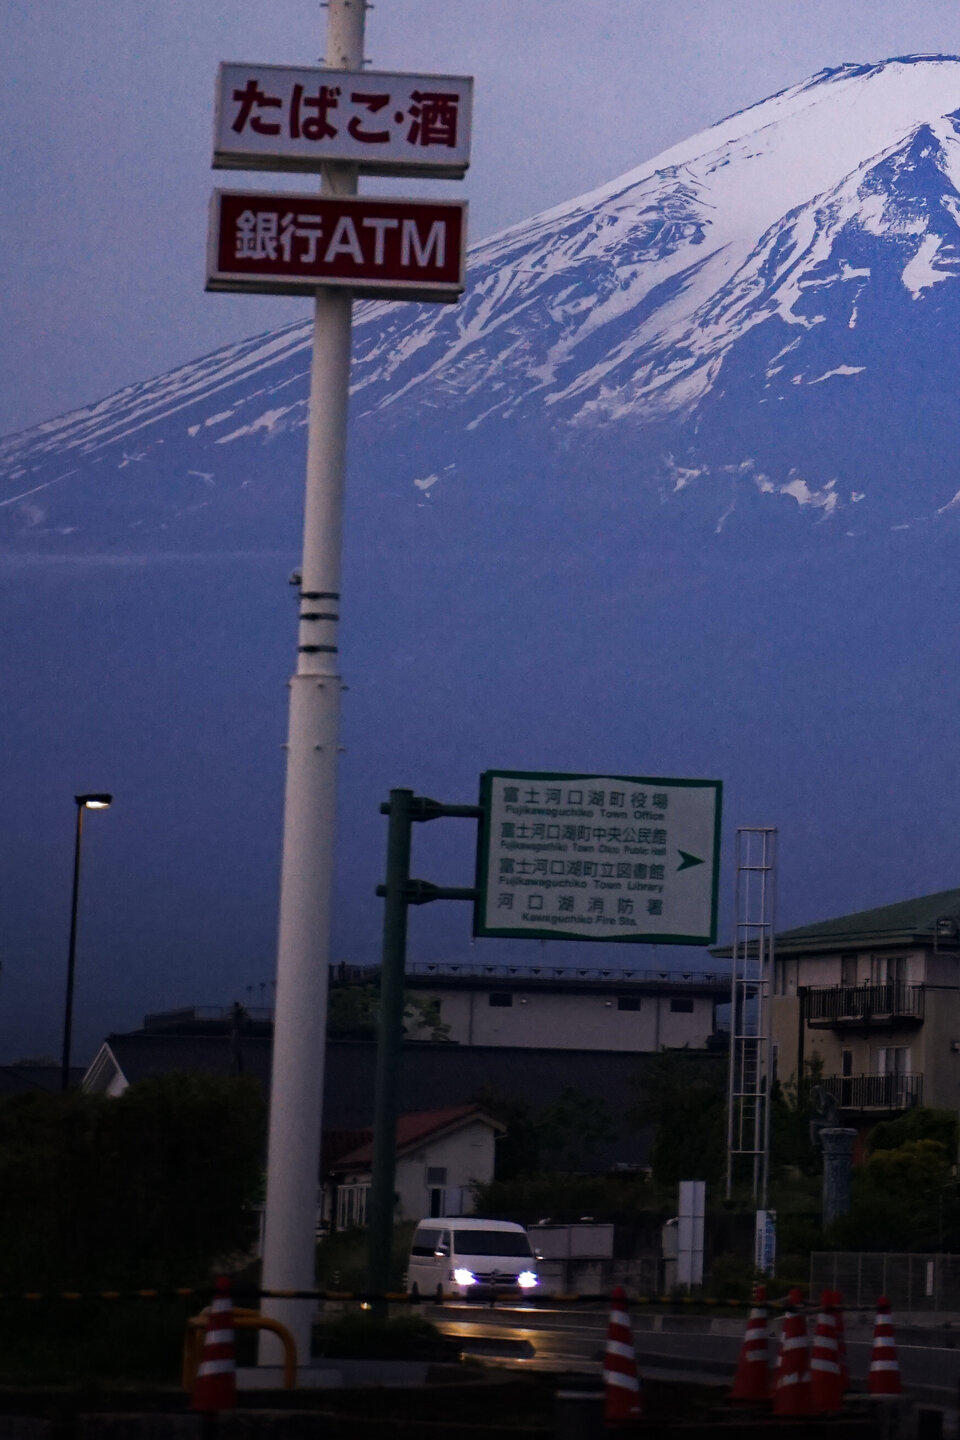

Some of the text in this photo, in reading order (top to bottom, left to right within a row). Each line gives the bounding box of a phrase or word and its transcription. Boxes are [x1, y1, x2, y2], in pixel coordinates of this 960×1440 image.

[235, 210, 447, 268] 銀行ATM
[503, 786, 668, 810] 富士河口湖町役場
[505, 805, 665, 821] Fujikawaguchiko Town Office
[501, 822, 668, 845] 富士河口湖町中央公民館
[499, 858, 666, 881] 富士河口湖町立図書館
[498, 876, 665, 894] Fujikawaguchiko Town Library
[497, 893, 664, 916] 河口湖消防署
[522, 913, 593, 925] Kawaguchiko
[595, 915, 616, 925] Fire
